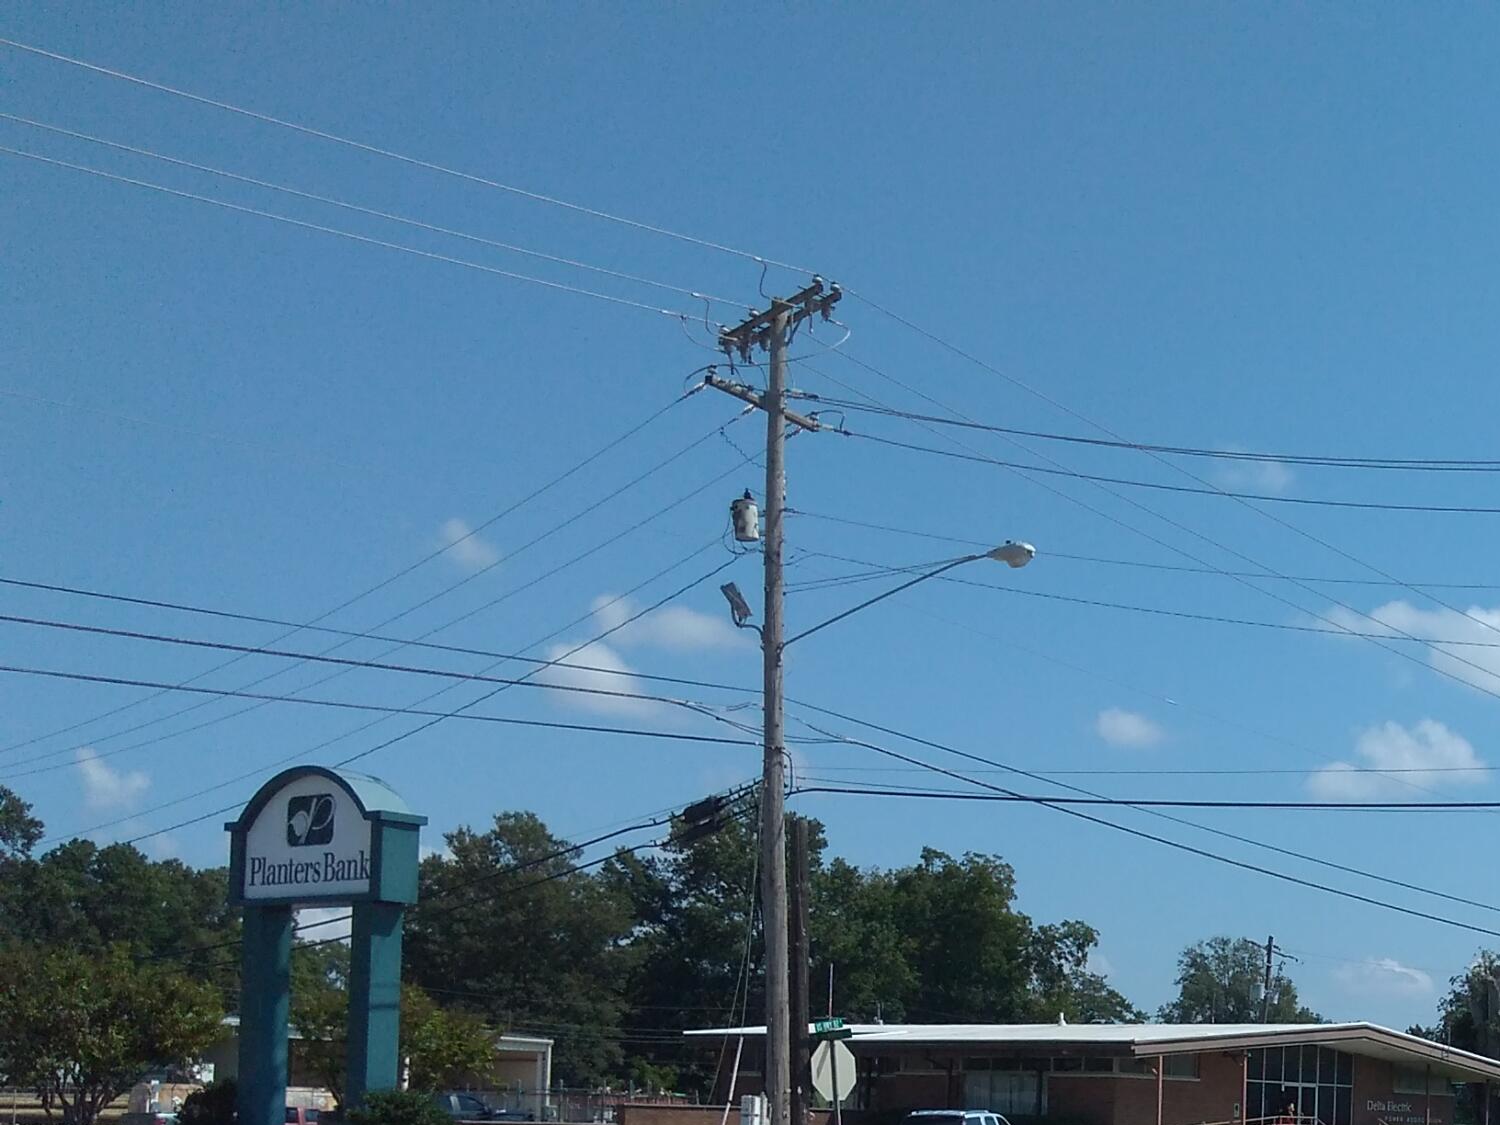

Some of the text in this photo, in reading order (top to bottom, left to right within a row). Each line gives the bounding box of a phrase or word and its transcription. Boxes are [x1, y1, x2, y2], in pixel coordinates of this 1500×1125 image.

[249, 851, 370, 886] Planters Bank
[1367, 1100, 1412, 1112] Delta Electric
